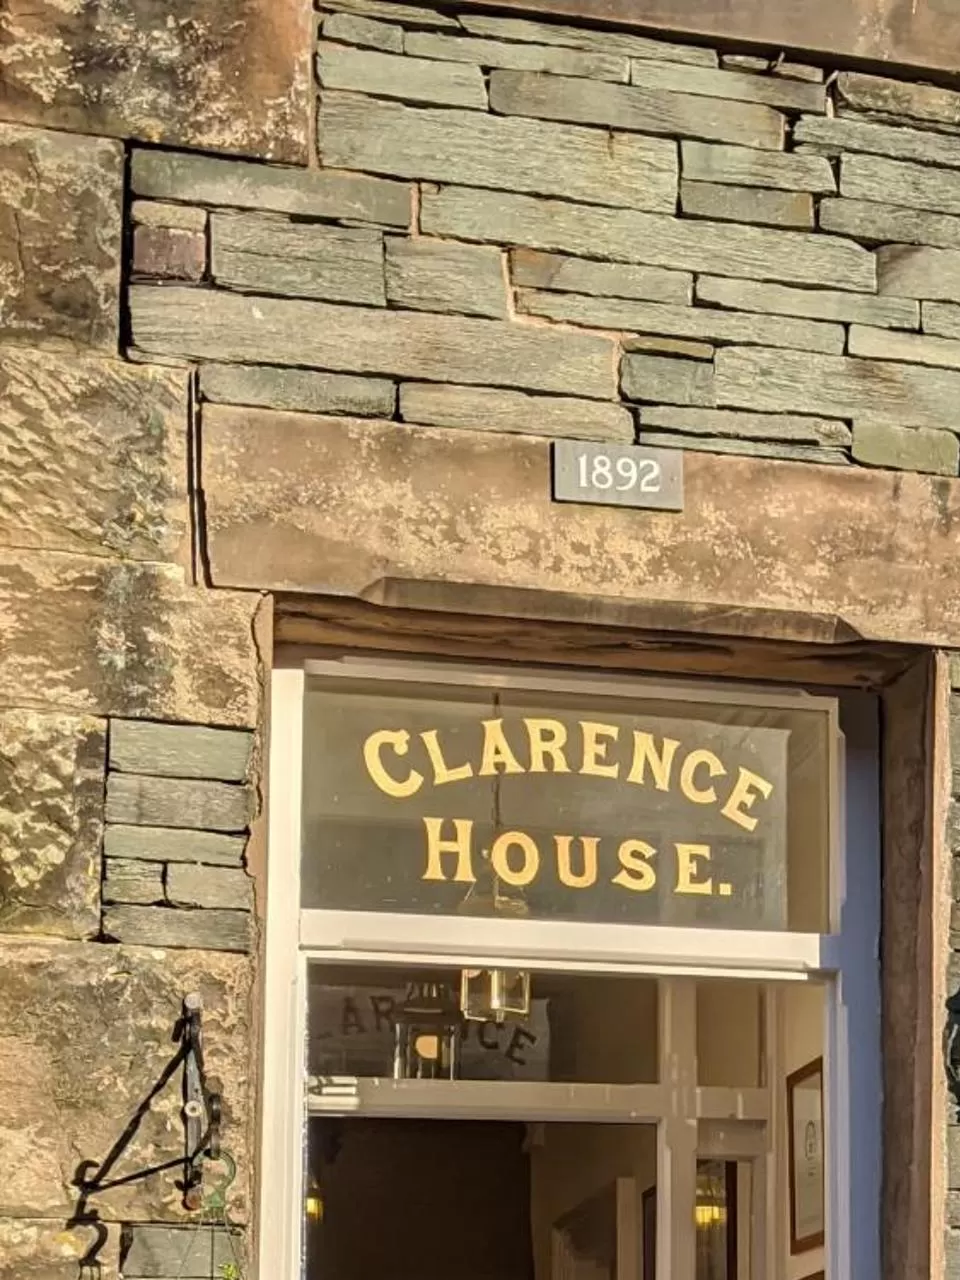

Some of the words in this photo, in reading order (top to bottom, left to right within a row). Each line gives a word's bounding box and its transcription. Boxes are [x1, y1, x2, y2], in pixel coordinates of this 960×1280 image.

[578, 453, 661, 492] 1892
[363, 717, 774, 832] CLARENCE
[421, 816, 732, 896] HOUSE.
